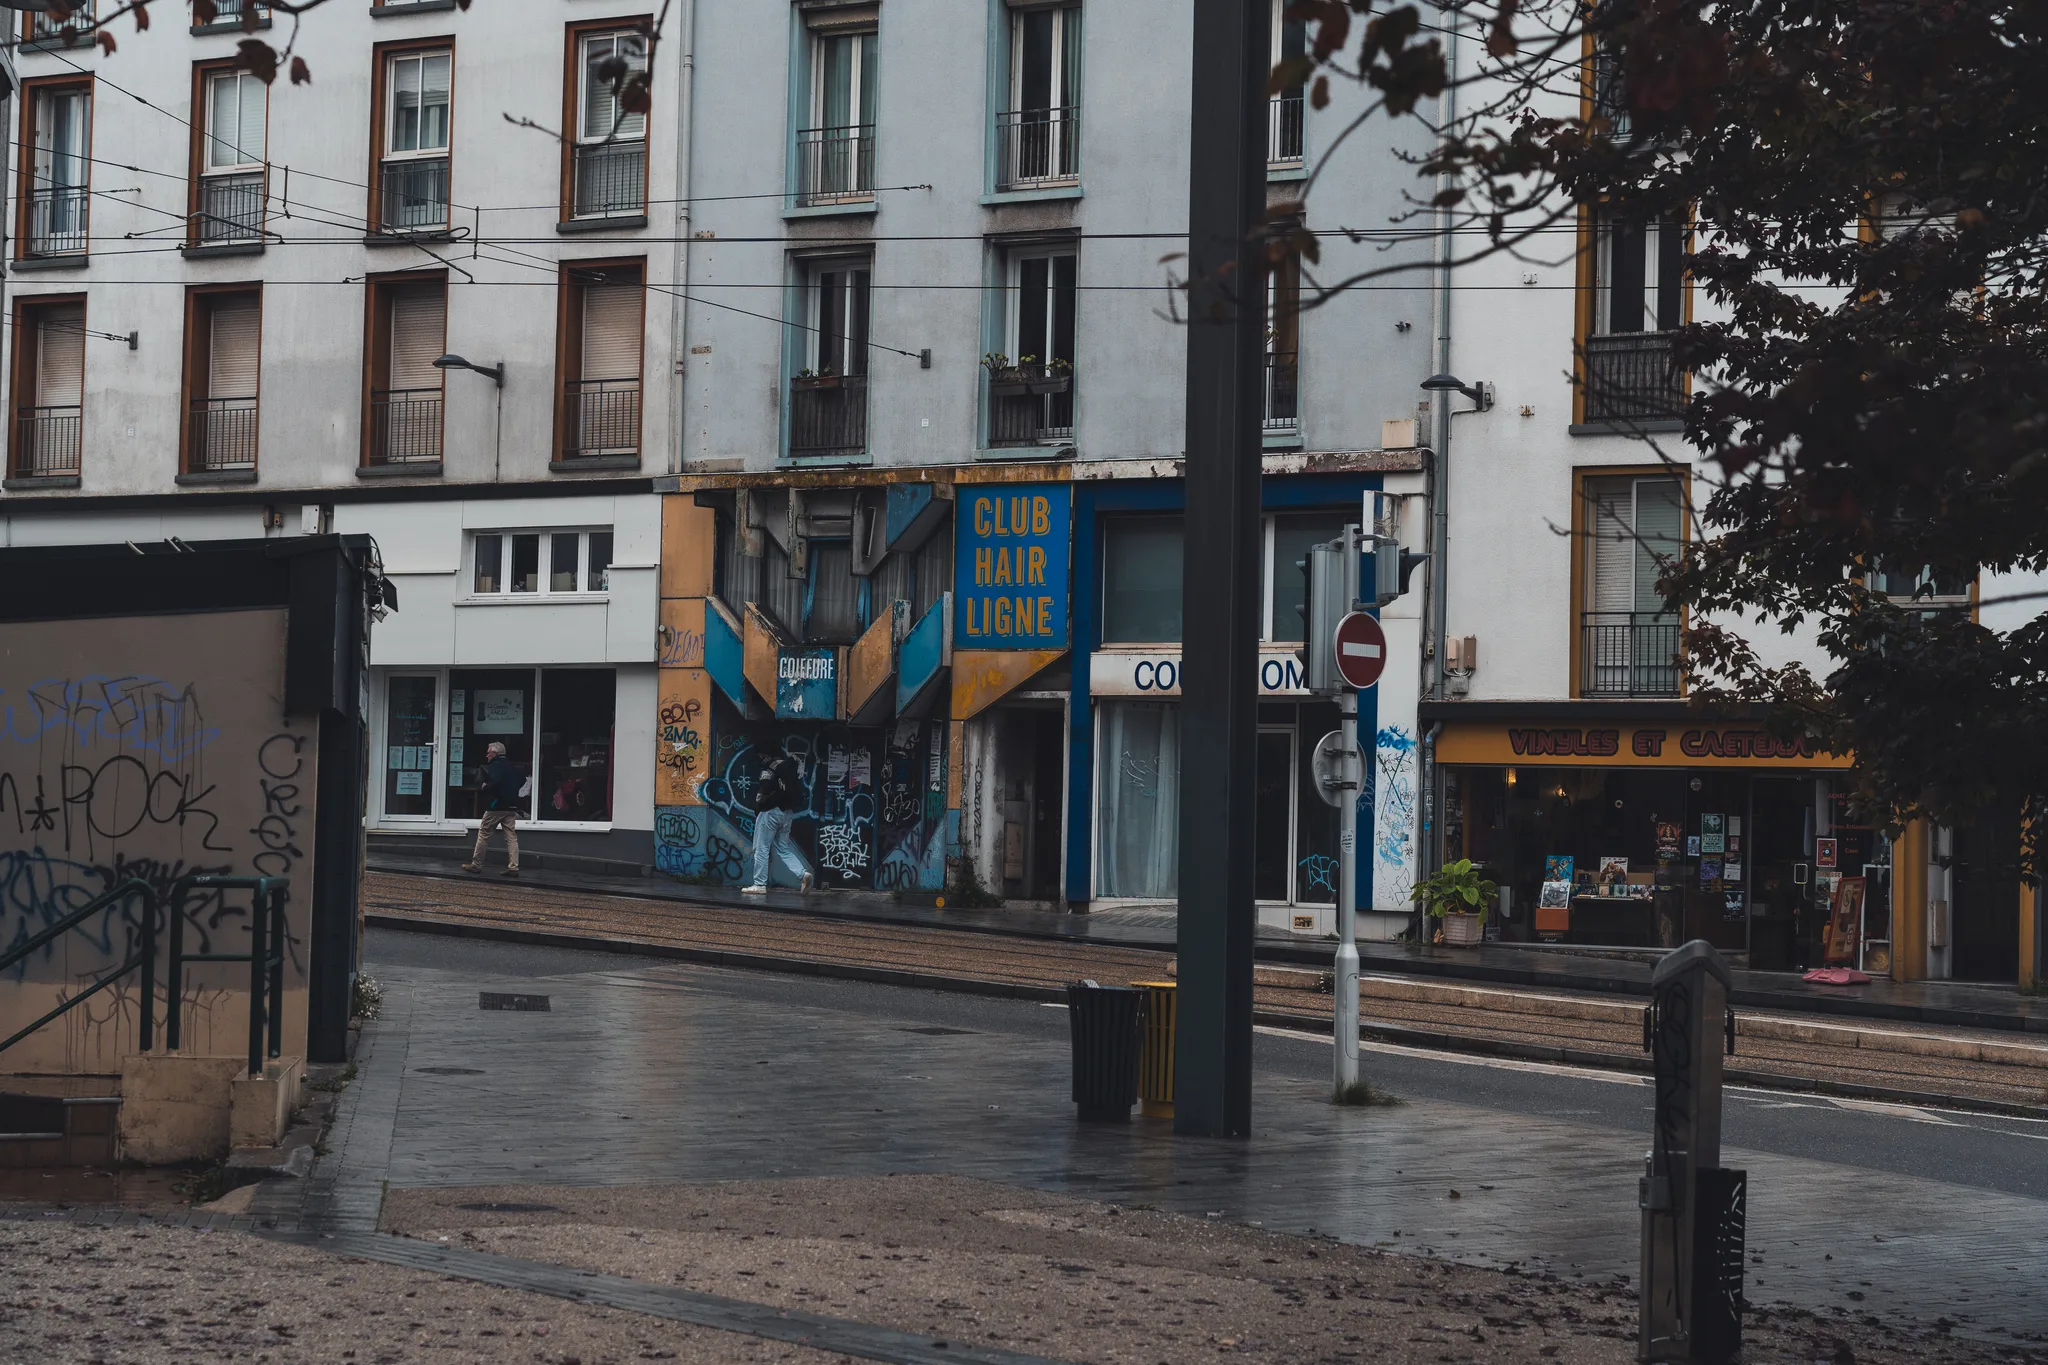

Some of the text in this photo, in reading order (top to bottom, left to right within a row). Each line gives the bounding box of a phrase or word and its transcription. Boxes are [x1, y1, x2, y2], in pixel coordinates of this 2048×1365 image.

[974, 496, 1051, 538] CLUB
[975, 546, 1048, 587] HAIR
[966, 597, 1055, 638] LIGNE
[779, 656, 834, 680] COIFFURE
[1508, 729, 1620, 757] VINYLES
[1632, 730, 1667, 758] ET
